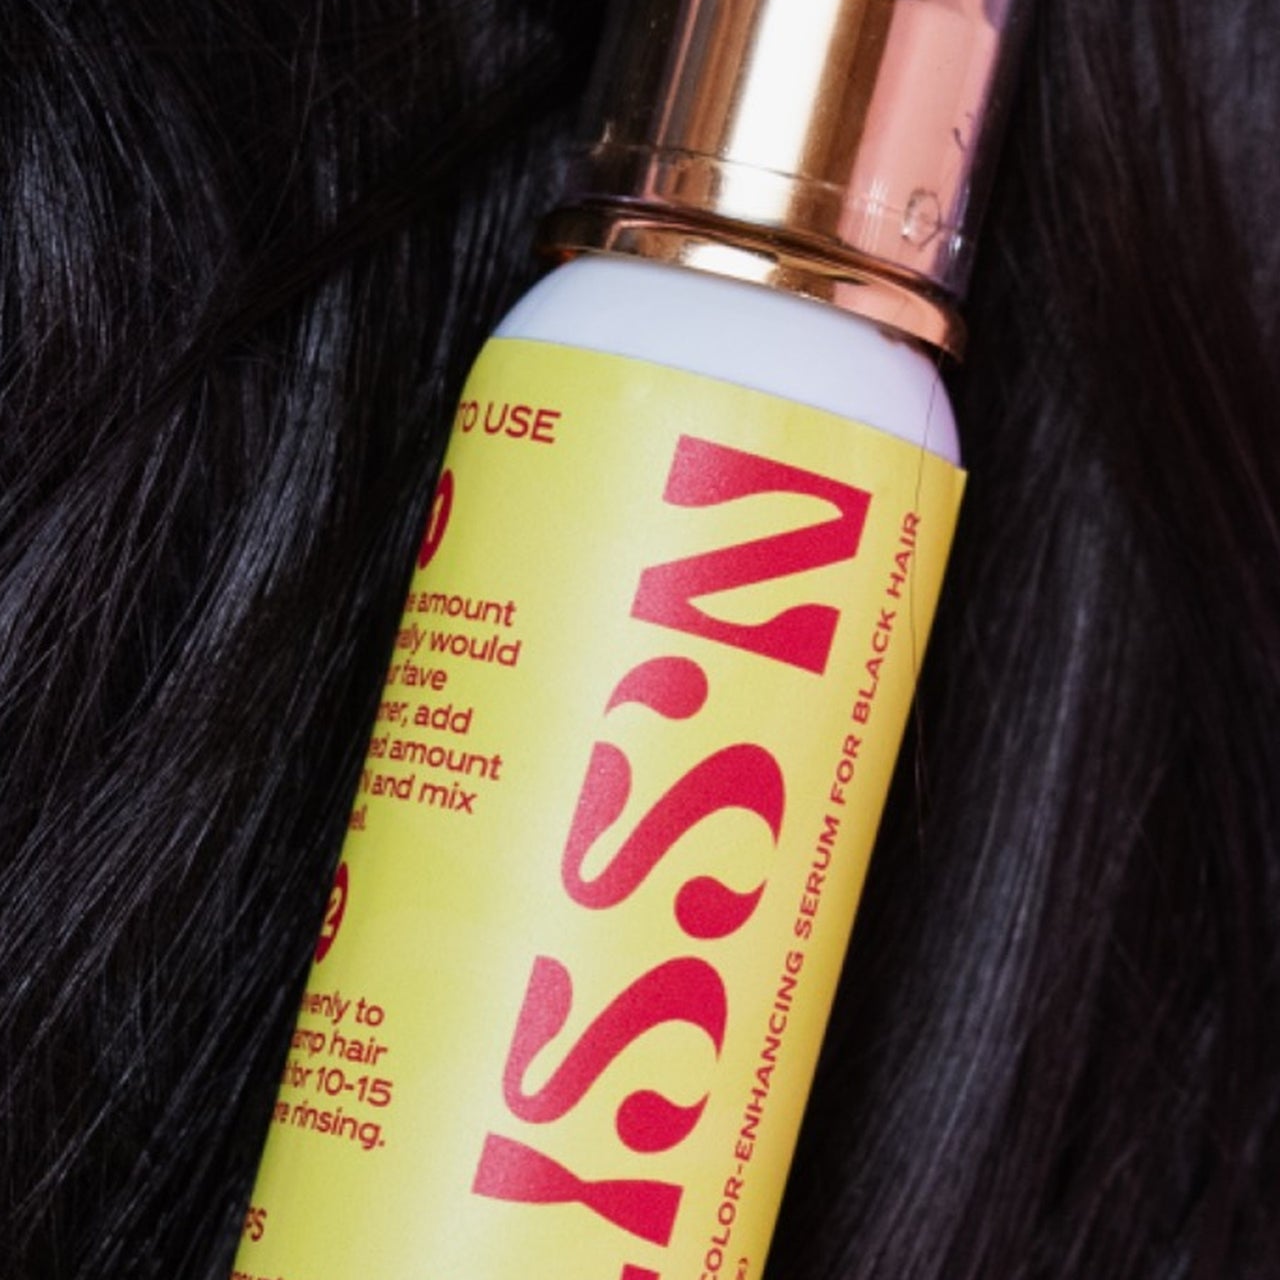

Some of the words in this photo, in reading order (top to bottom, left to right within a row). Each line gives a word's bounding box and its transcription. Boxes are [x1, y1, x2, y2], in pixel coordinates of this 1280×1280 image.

[483, 404, 561, 444] USE
[416, 592, 516, 628] amount
[429, 632, 521, 667] would
[401, 660, 448, 692] fave
[413, 704, 474, 735] add
[793, 814, 841, 940] SERUM
[829, 733, 863, 807] FOR
[851, 609, 897, 726] BLACK
[885, 511, 921, 600] HAIR
[388, 739, 502, 781] amount
[370, 774, 416, 801] and
[418, 782, 477, 814] mix
[354, 999, 385, 1027] to
[329, 1032, 388, 1065] hair
[317, 1066, 393, 1108] 10-15
[293, 1104, 385, 1151] rinsing.
